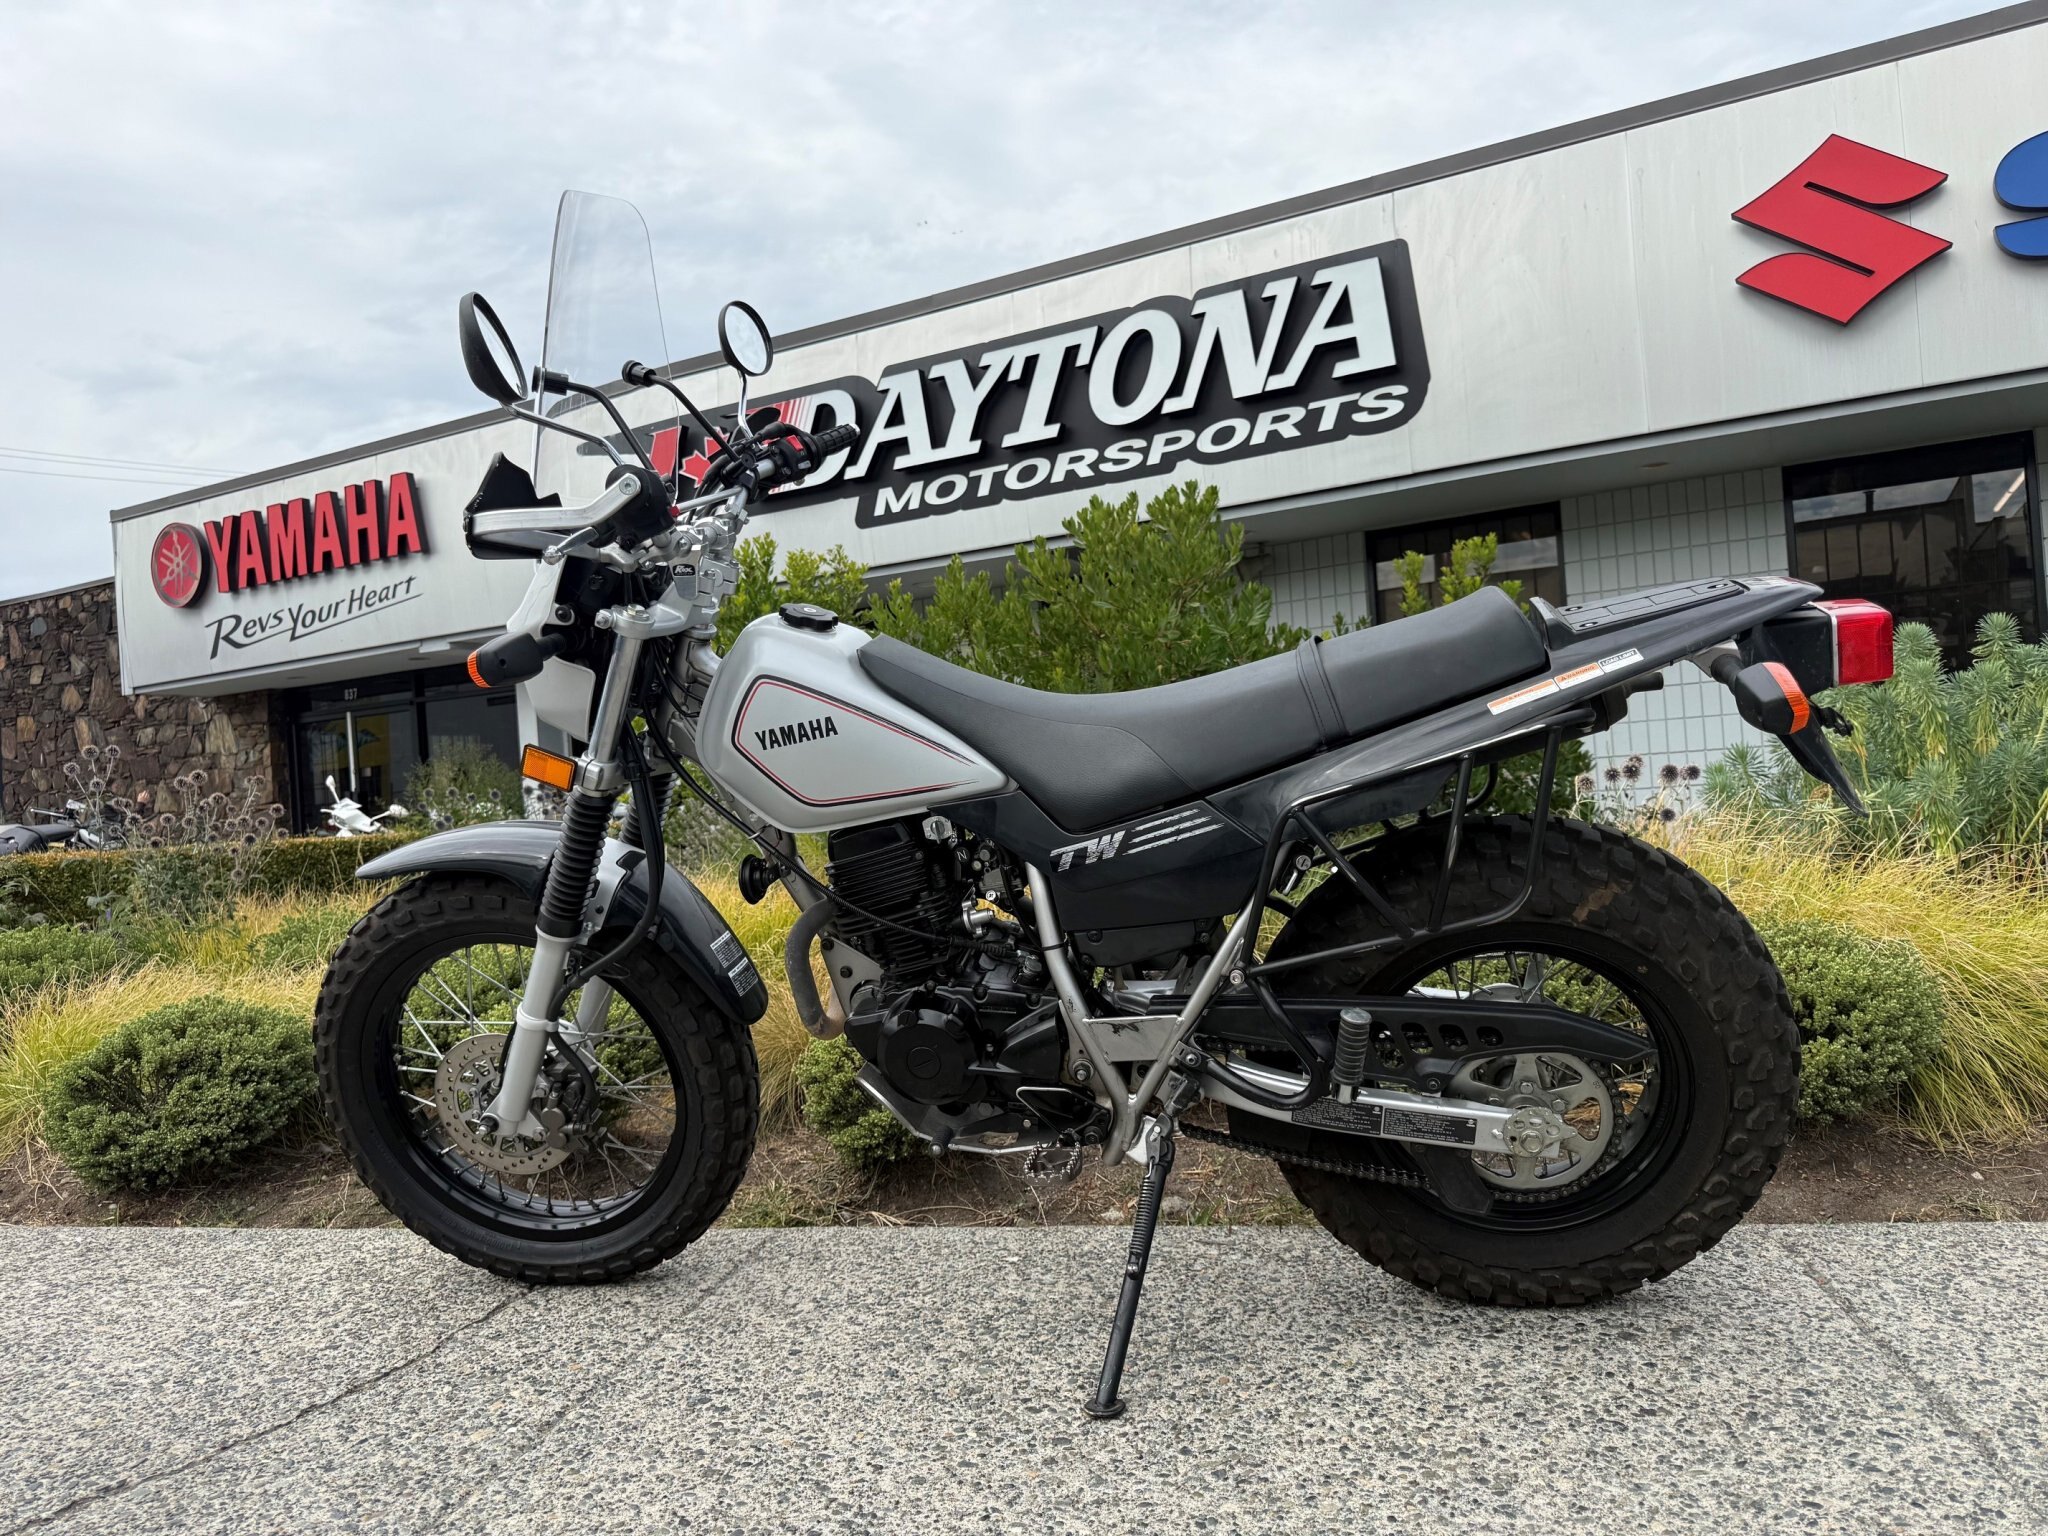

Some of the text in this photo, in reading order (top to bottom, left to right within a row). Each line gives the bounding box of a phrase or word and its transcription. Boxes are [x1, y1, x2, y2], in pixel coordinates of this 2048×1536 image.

[769, 257, 1397, 495] DAYTONA
[873, 385, 1408, 517] MOTORSPORTS
[204, 472, 424, 593] YAMAHA
[205, 575, 417, 660] Revs Your Heart
[754, 716, 839, 751] YAMAHA
[1050, 829, 1126, 872] TW
